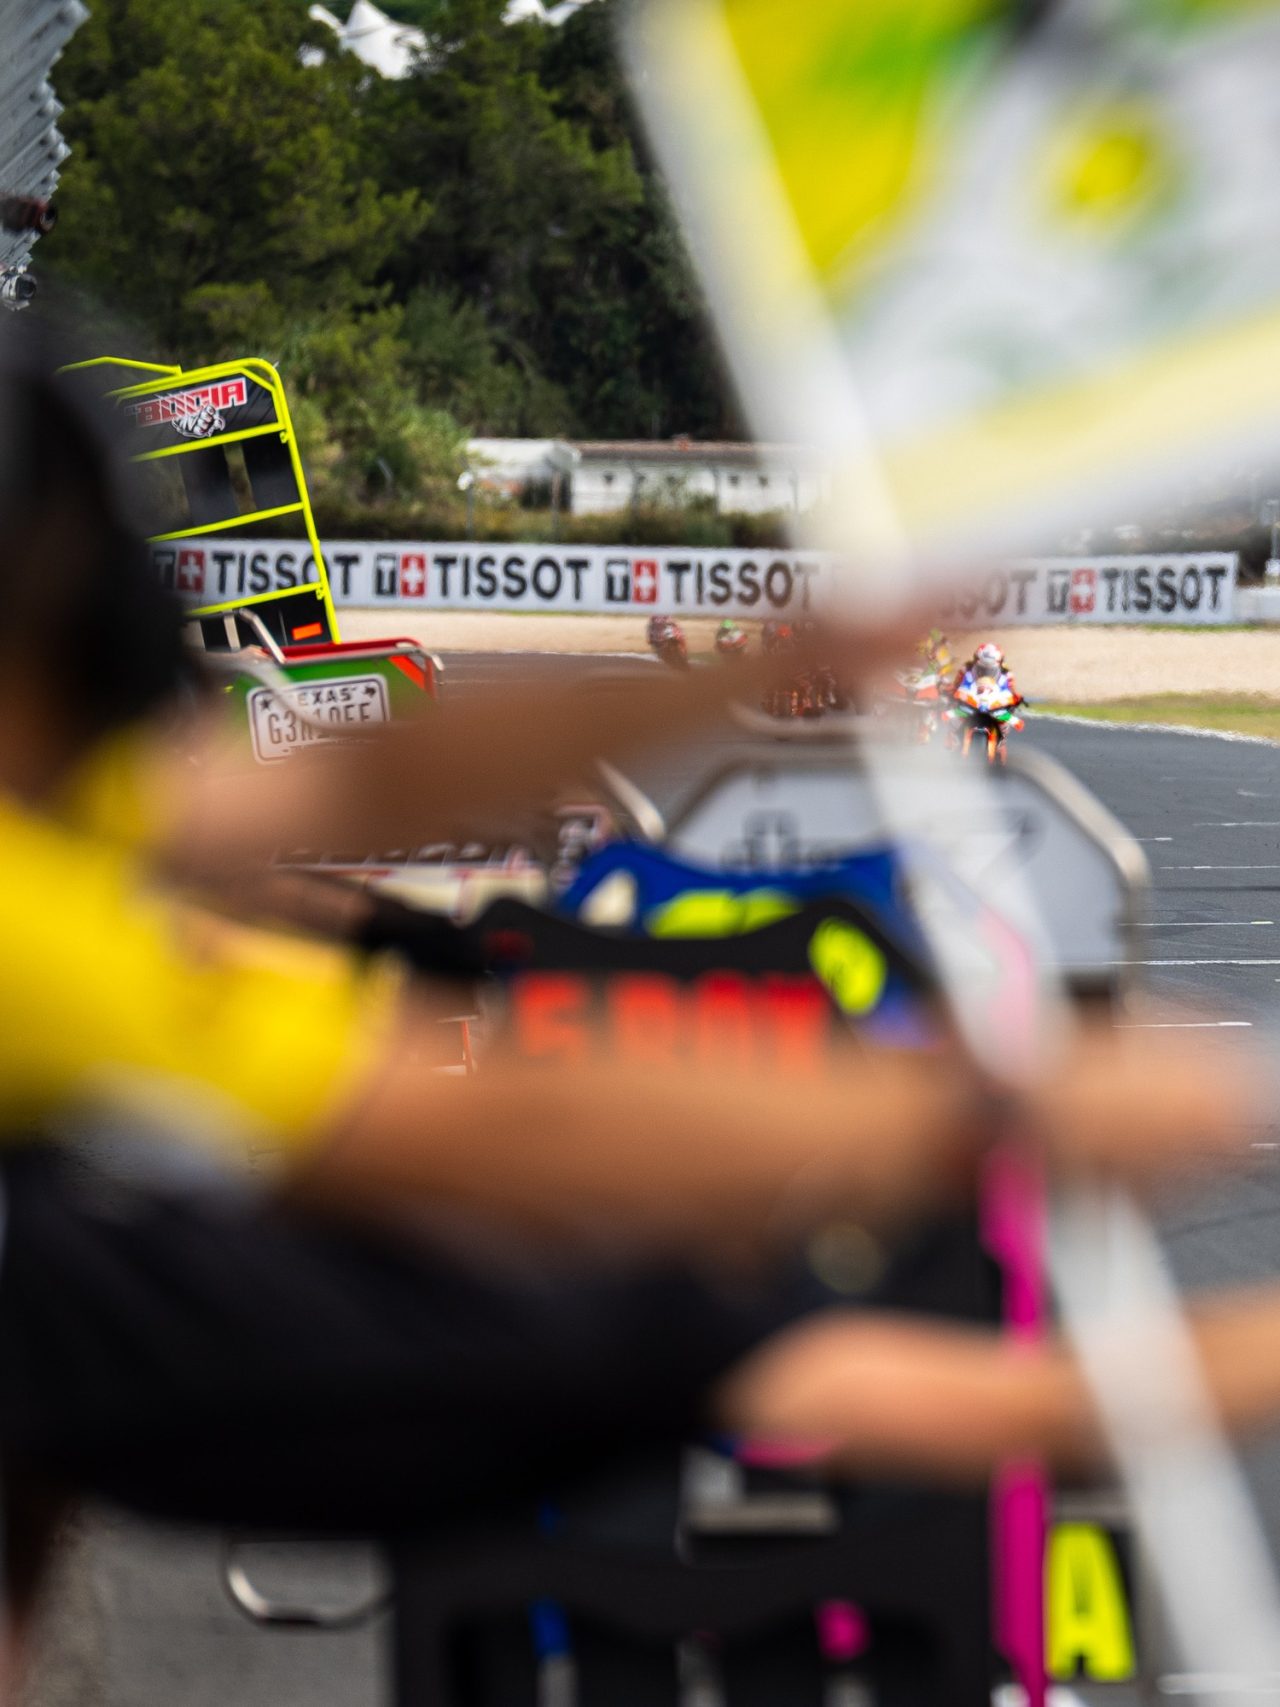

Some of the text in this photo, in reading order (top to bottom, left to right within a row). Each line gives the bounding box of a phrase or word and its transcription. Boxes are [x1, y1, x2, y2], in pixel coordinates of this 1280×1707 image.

[212, 552, 360, 596] TISSOT
[433, 554, 590, 601] TISSOT
[666, 559, 820, 611] TISSOT
[1101, 566, 1228, 613] TISSOT
